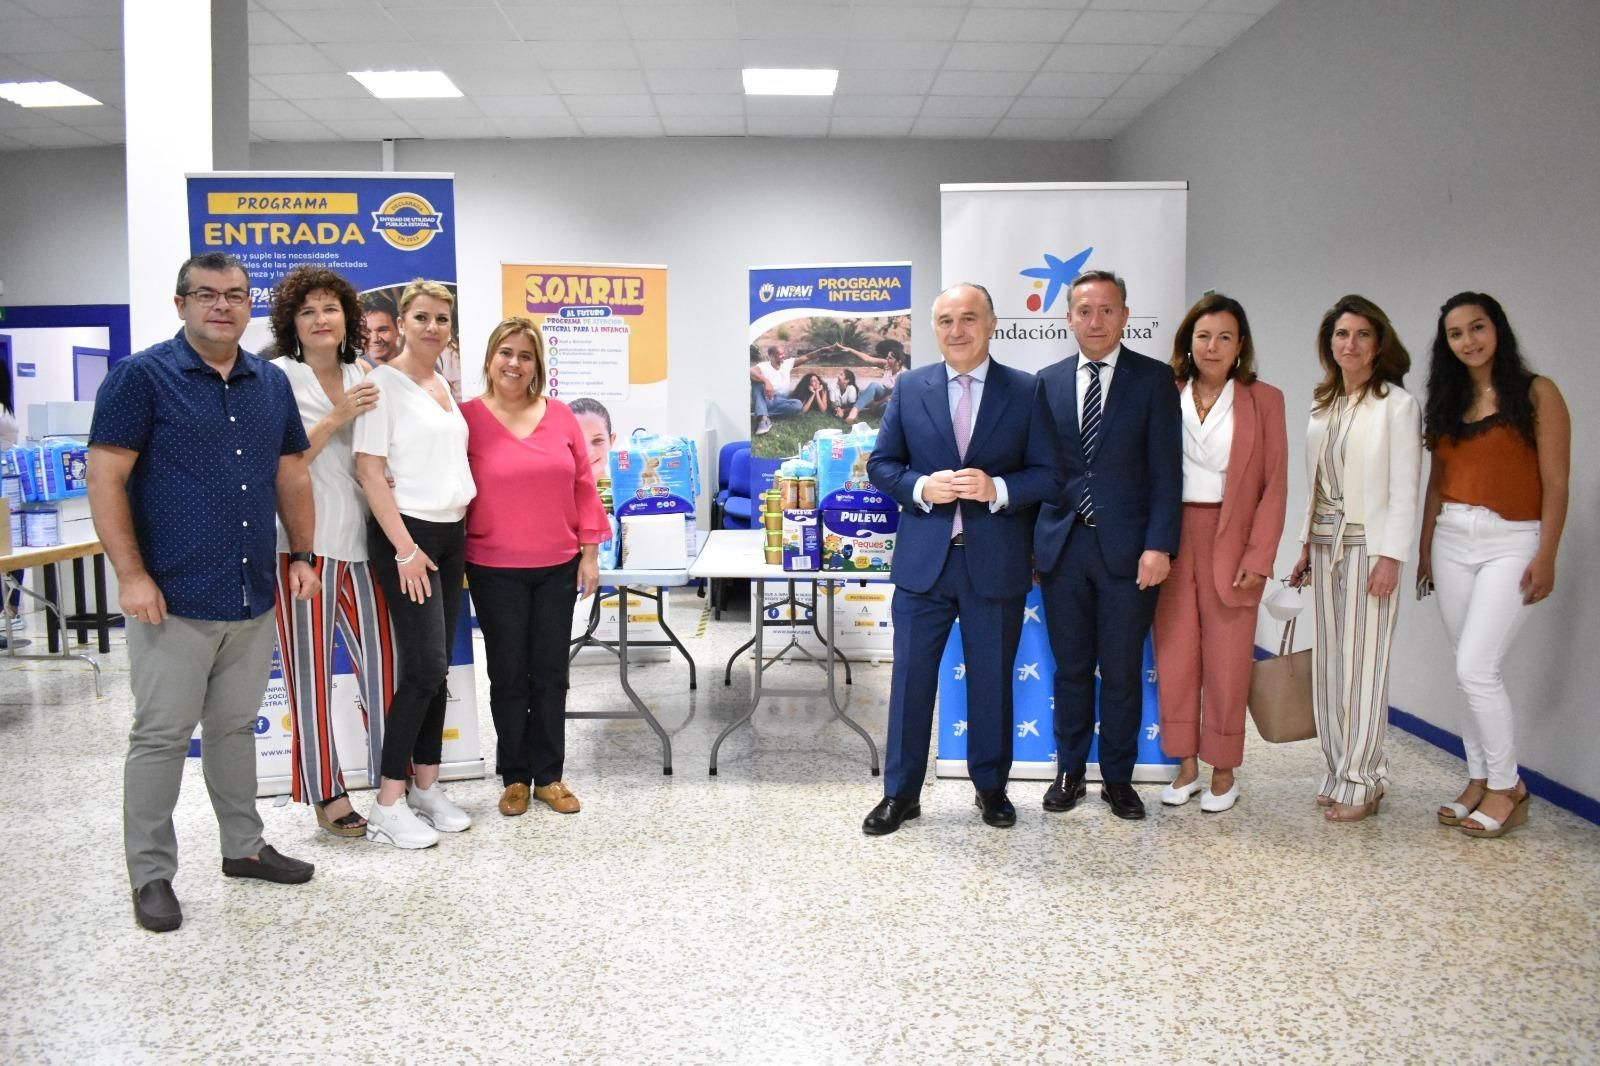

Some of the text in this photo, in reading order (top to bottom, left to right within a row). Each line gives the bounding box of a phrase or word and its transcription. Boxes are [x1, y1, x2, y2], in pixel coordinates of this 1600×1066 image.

[237, 196, 329, 211] PROGRAMA
[204, 222, 366, 246] ENTRADA
[242, 253, 248, 261] y
[249, 252, 273, 261] suple
[818, 277, 901, 290] PROGRAMA
[829, 289, 891, 302] INTEGRA
[990, 323, 1067, 340] ndación
[841, 511, 887, 523] PULEVA
[853, 539, 894, 551] Peques 3
